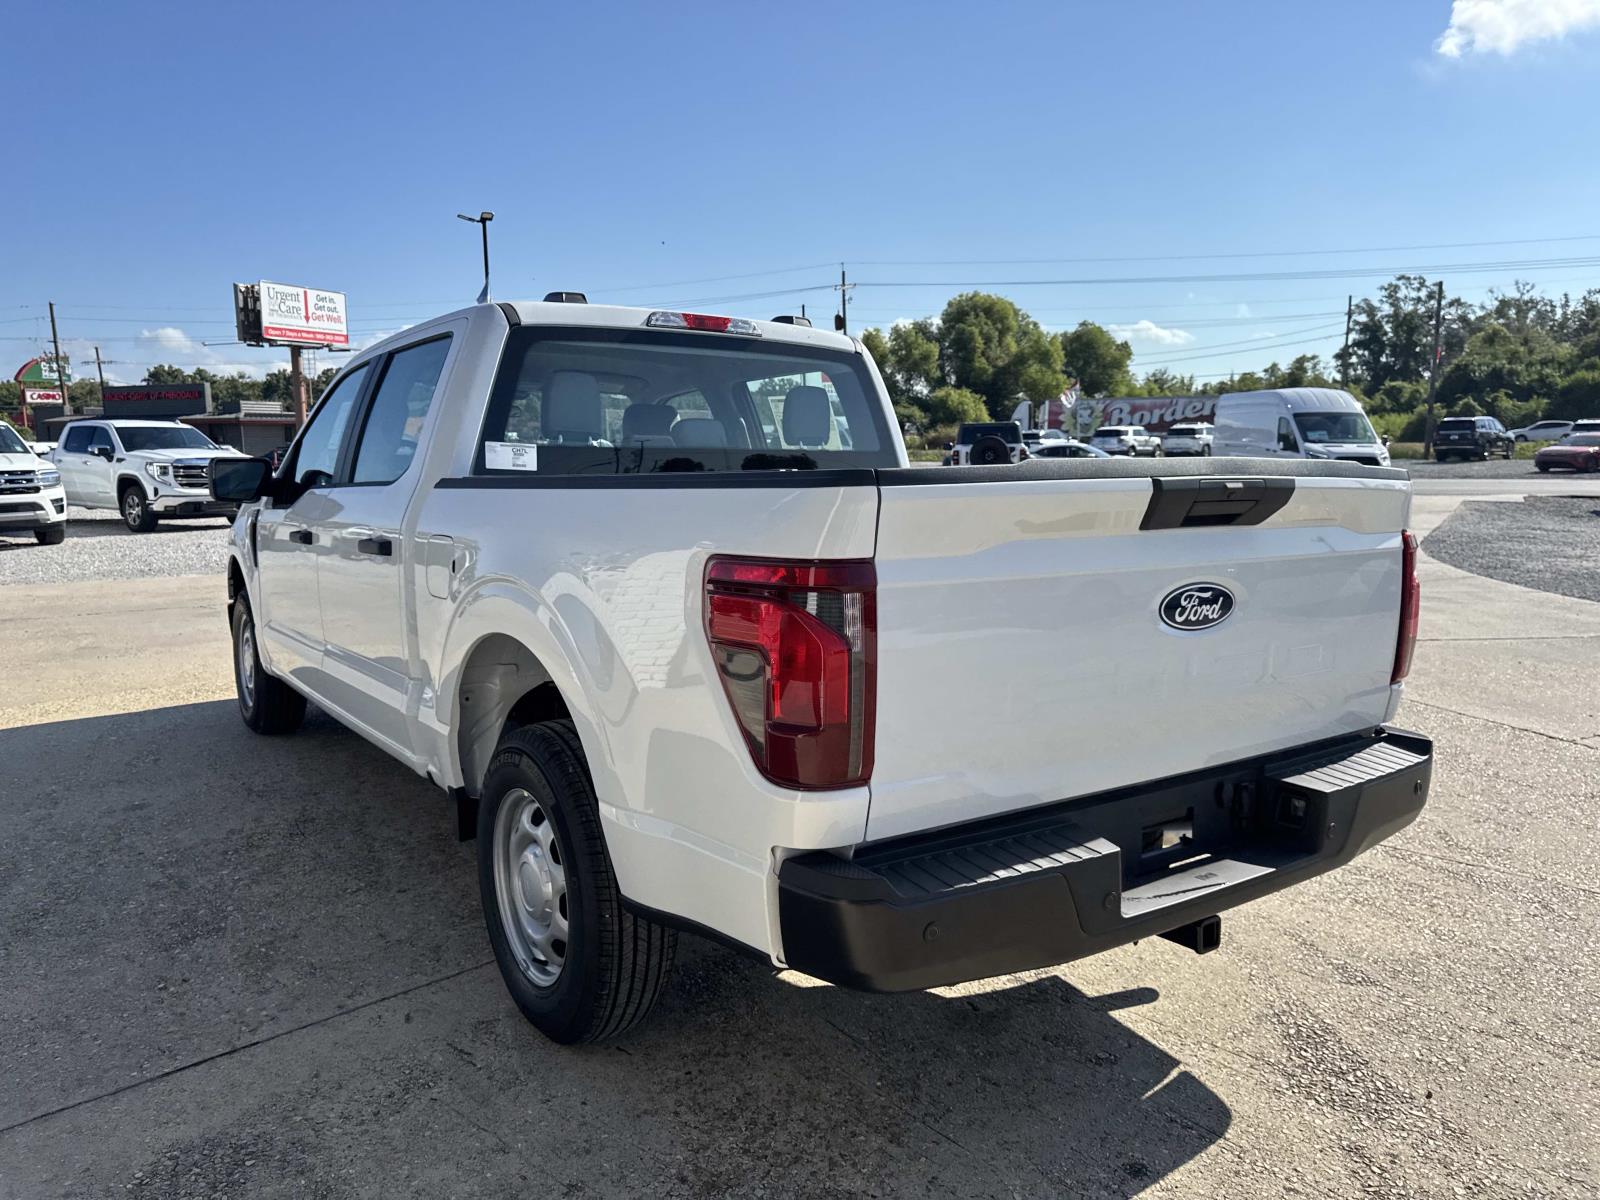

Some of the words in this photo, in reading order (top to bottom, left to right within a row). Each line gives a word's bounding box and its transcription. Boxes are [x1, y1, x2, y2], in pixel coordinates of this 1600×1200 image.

[267, 287, 300, 304] Urgent
[316, 294, 327, 303] Get
[328, 296, 336, 304] in.
[279, 301, 302, 314] Care
[314, 303, 326, 312] Get
[327, 305, 338, 313] out.
[311, 312, 325, 322] Get
[326, 313, 343, 325] Well.
[30, 392, 61, 400] CASINO
[1175, 591, 1223, 622] Ford
